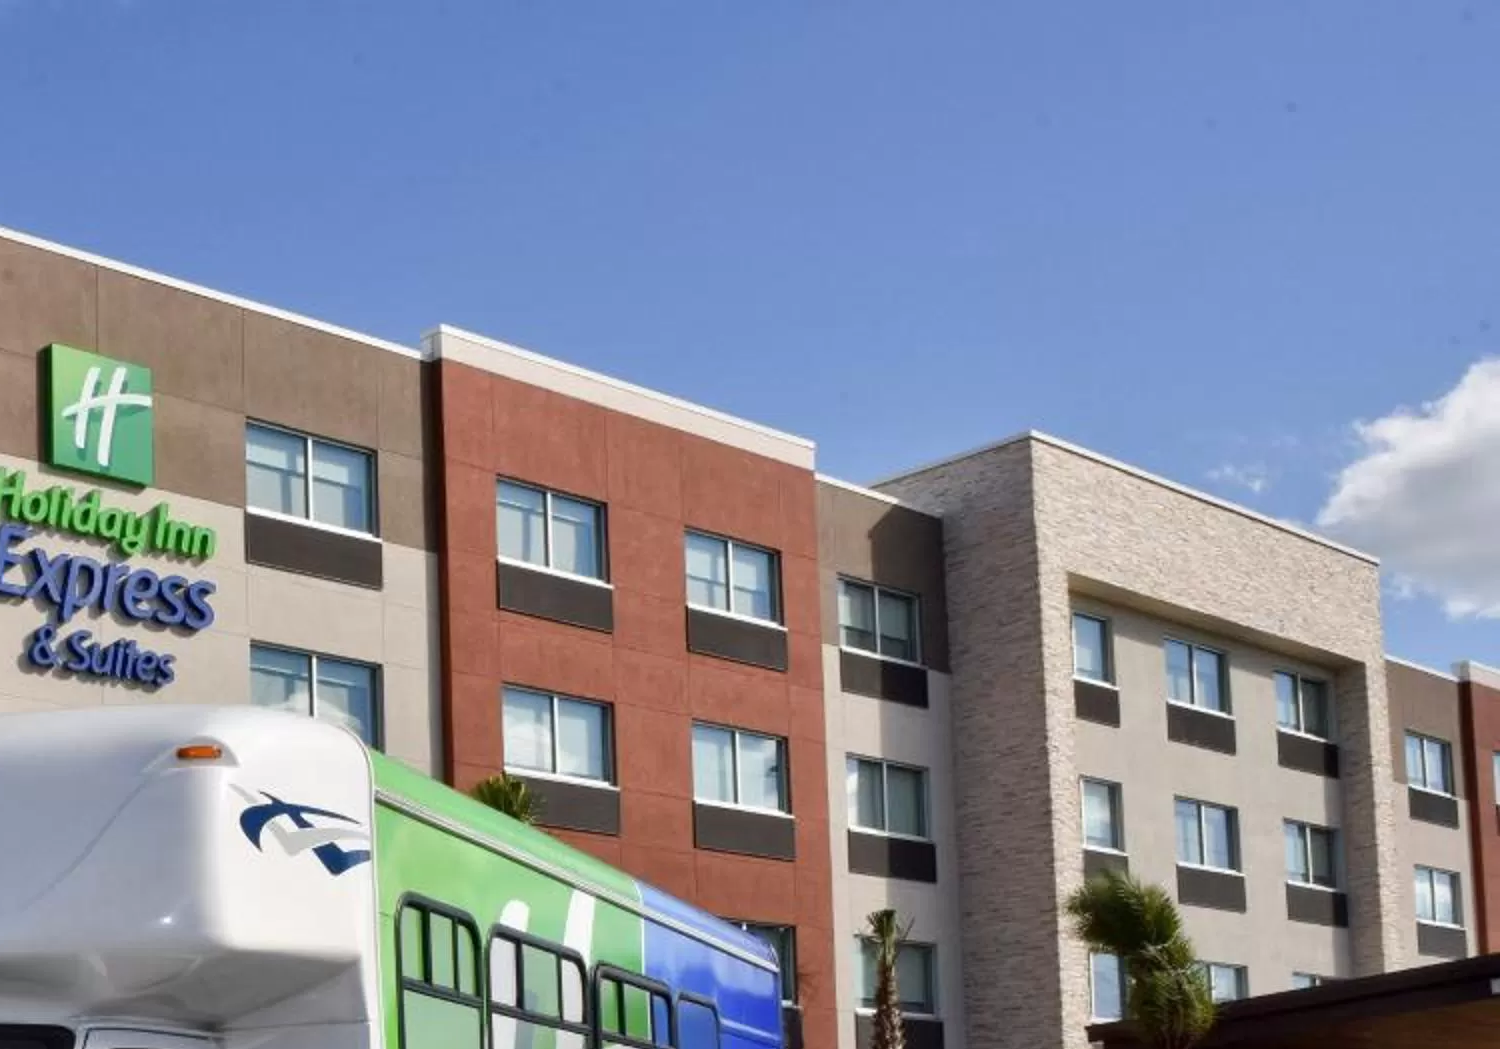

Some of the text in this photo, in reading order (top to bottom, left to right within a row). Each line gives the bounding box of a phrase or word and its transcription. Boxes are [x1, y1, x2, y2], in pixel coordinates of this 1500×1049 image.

[152, 501, 216, 560] Inn
[27, 622, 177, 688] & Suites
